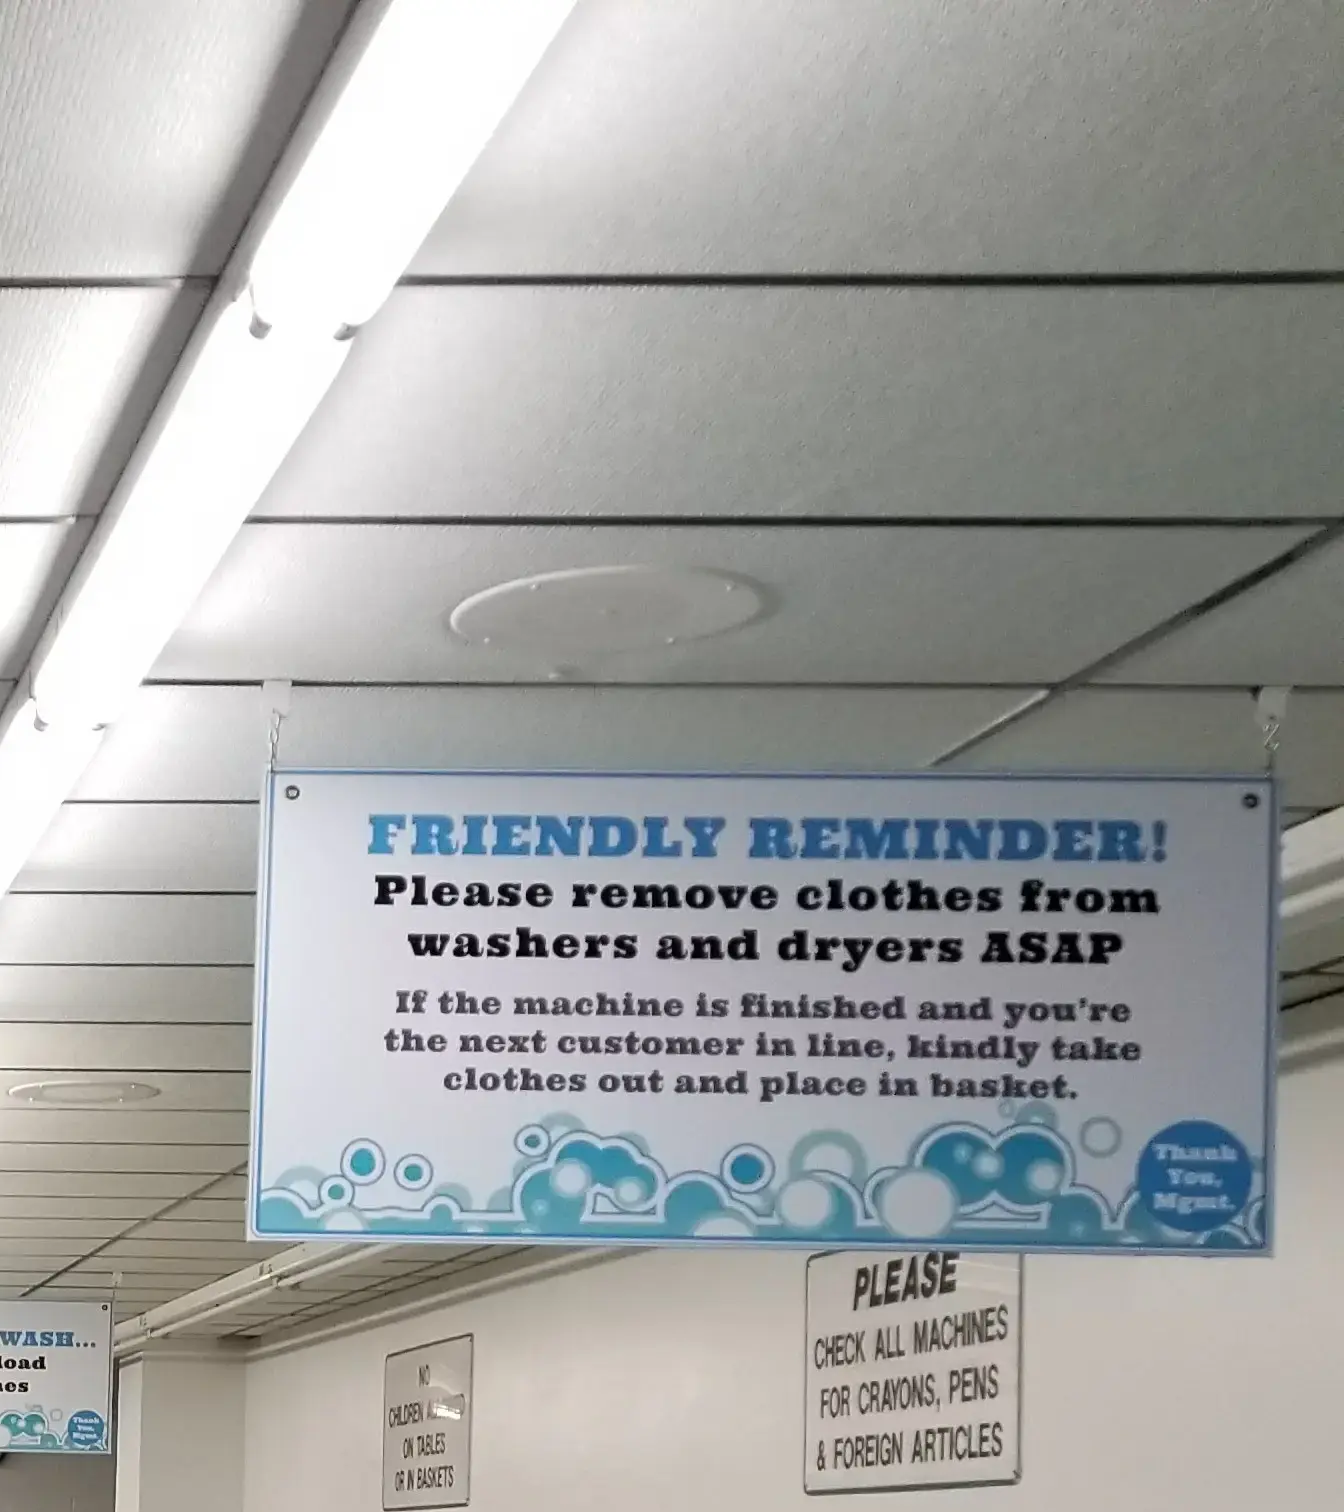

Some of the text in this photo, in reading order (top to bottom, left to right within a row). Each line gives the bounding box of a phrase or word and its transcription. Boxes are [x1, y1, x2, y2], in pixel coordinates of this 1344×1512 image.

[368, 813, 1169, 864] FRIENDLY REMINDER!
[373, 874, 1160, 915] Please remove clothes from
[407, 926, 1124, 973] washers and dryers ASAP
[395, 989, 1132, 1029] If the machine is finished and you're
[383, 1028, 1142, 1068] the next customer in line, kindly take
[443, 1067, 1078, 1103] clothes out and place in basket.
[1153, 1143, 1238, 1160] Thank
[853, 1251, 960, 1311] PLEASE
[814, 1303, 1009, 1370] CHECK ALL MACHINES
[418, 1364, 431, 1387] NO
[820, 1364, 999, 1419] FOR CRAYONS, PENS
[388, 1402, 424, 1428] CHILDREN
[403, 1433, 446, 1459] ON TABLES
[816, 1422, 1004, 1471] & FOREIGN ARTICLES
[417, 1465, 455, 1489] BASKETS
